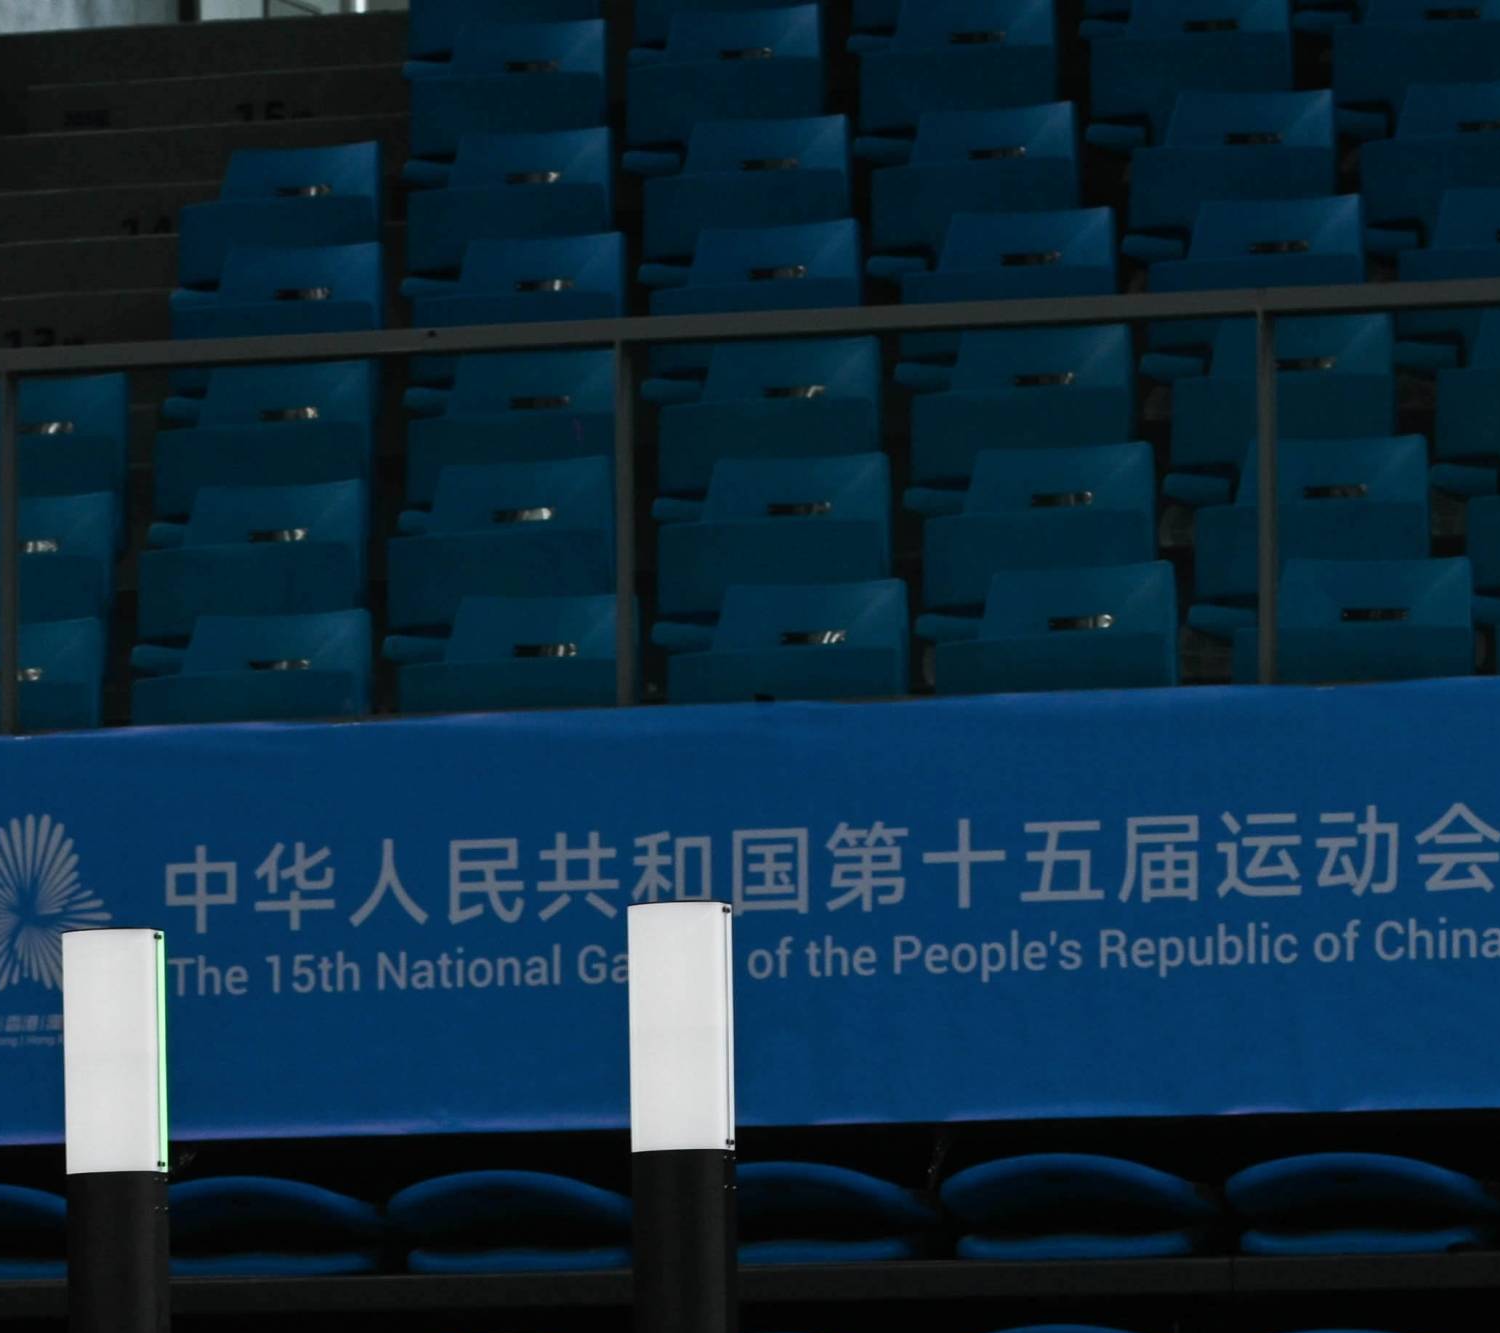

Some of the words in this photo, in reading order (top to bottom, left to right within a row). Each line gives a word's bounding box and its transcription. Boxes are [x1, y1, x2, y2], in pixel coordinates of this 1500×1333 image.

[167, 954, 248, 996] The
[265, 951, 361, 994] 15th
[377, 943, 562, 991] National
[747, 936, 794, 980] of
[805, 935, 878, 978] the
[893, 929, 1084, 983] People's
[1100, 922, 1299, 978] Republic
[1313, 918, 1362, 963] of
